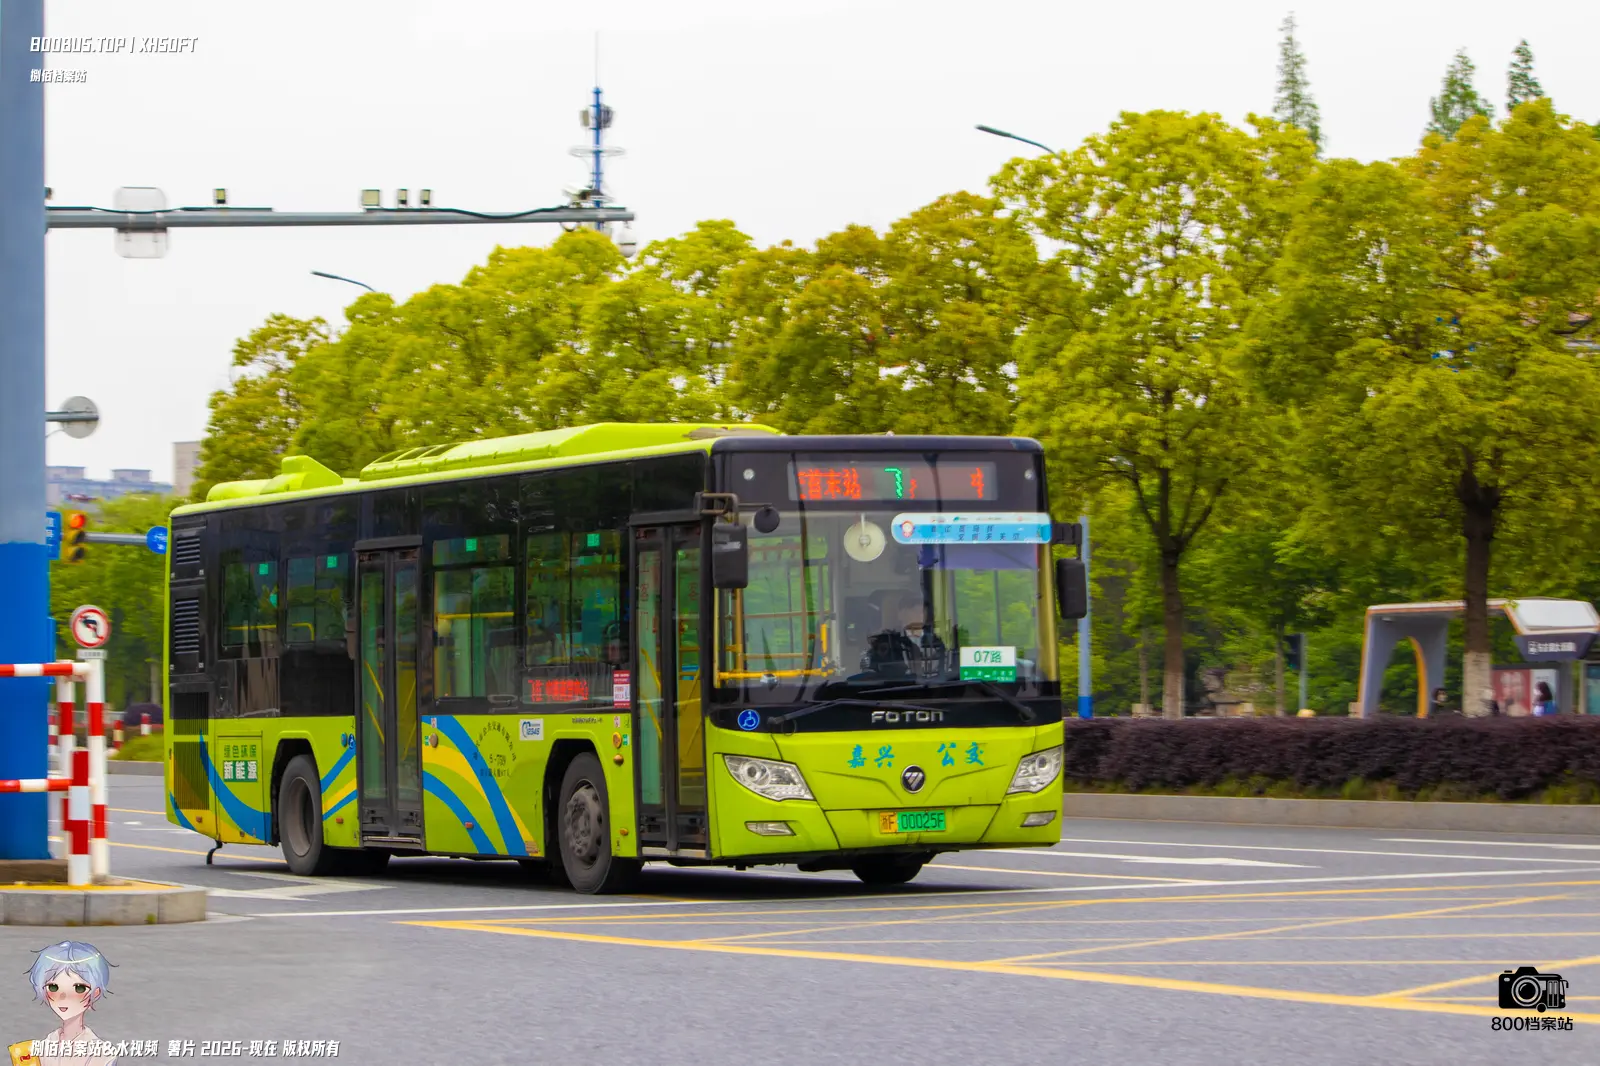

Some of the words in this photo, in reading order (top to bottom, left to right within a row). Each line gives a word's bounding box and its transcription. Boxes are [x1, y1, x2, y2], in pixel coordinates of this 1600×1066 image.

[974, 650, 1001, 663] 07路
[871, 710, 944, 723] FOTON
[223, 760, 257, 779] 新能源
